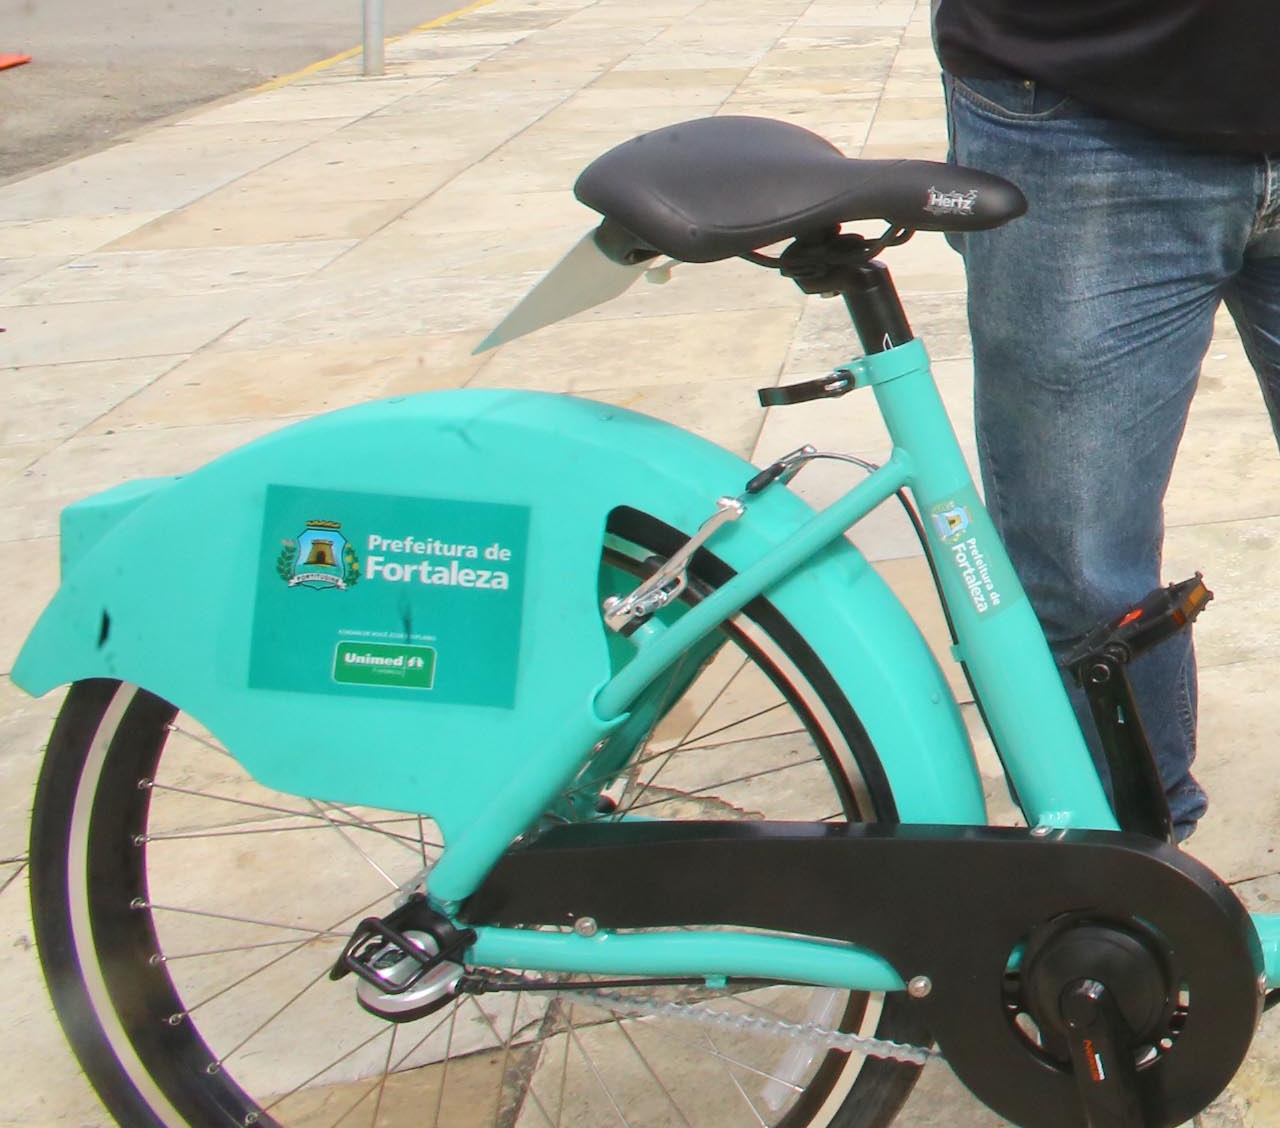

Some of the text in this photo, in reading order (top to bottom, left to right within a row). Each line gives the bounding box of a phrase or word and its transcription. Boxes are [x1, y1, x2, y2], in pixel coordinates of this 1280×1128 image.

[931, 192, 972, 210] Hertz
[368, 534, 512, 562] Prefeitura de
[365, 555, 509, 591] Fortaleza
[951, 543, 988, 613] Fortaleza
[966, 536, 1001, 606] Prefeitura de
[344, 652, 404, 667] Unimed
